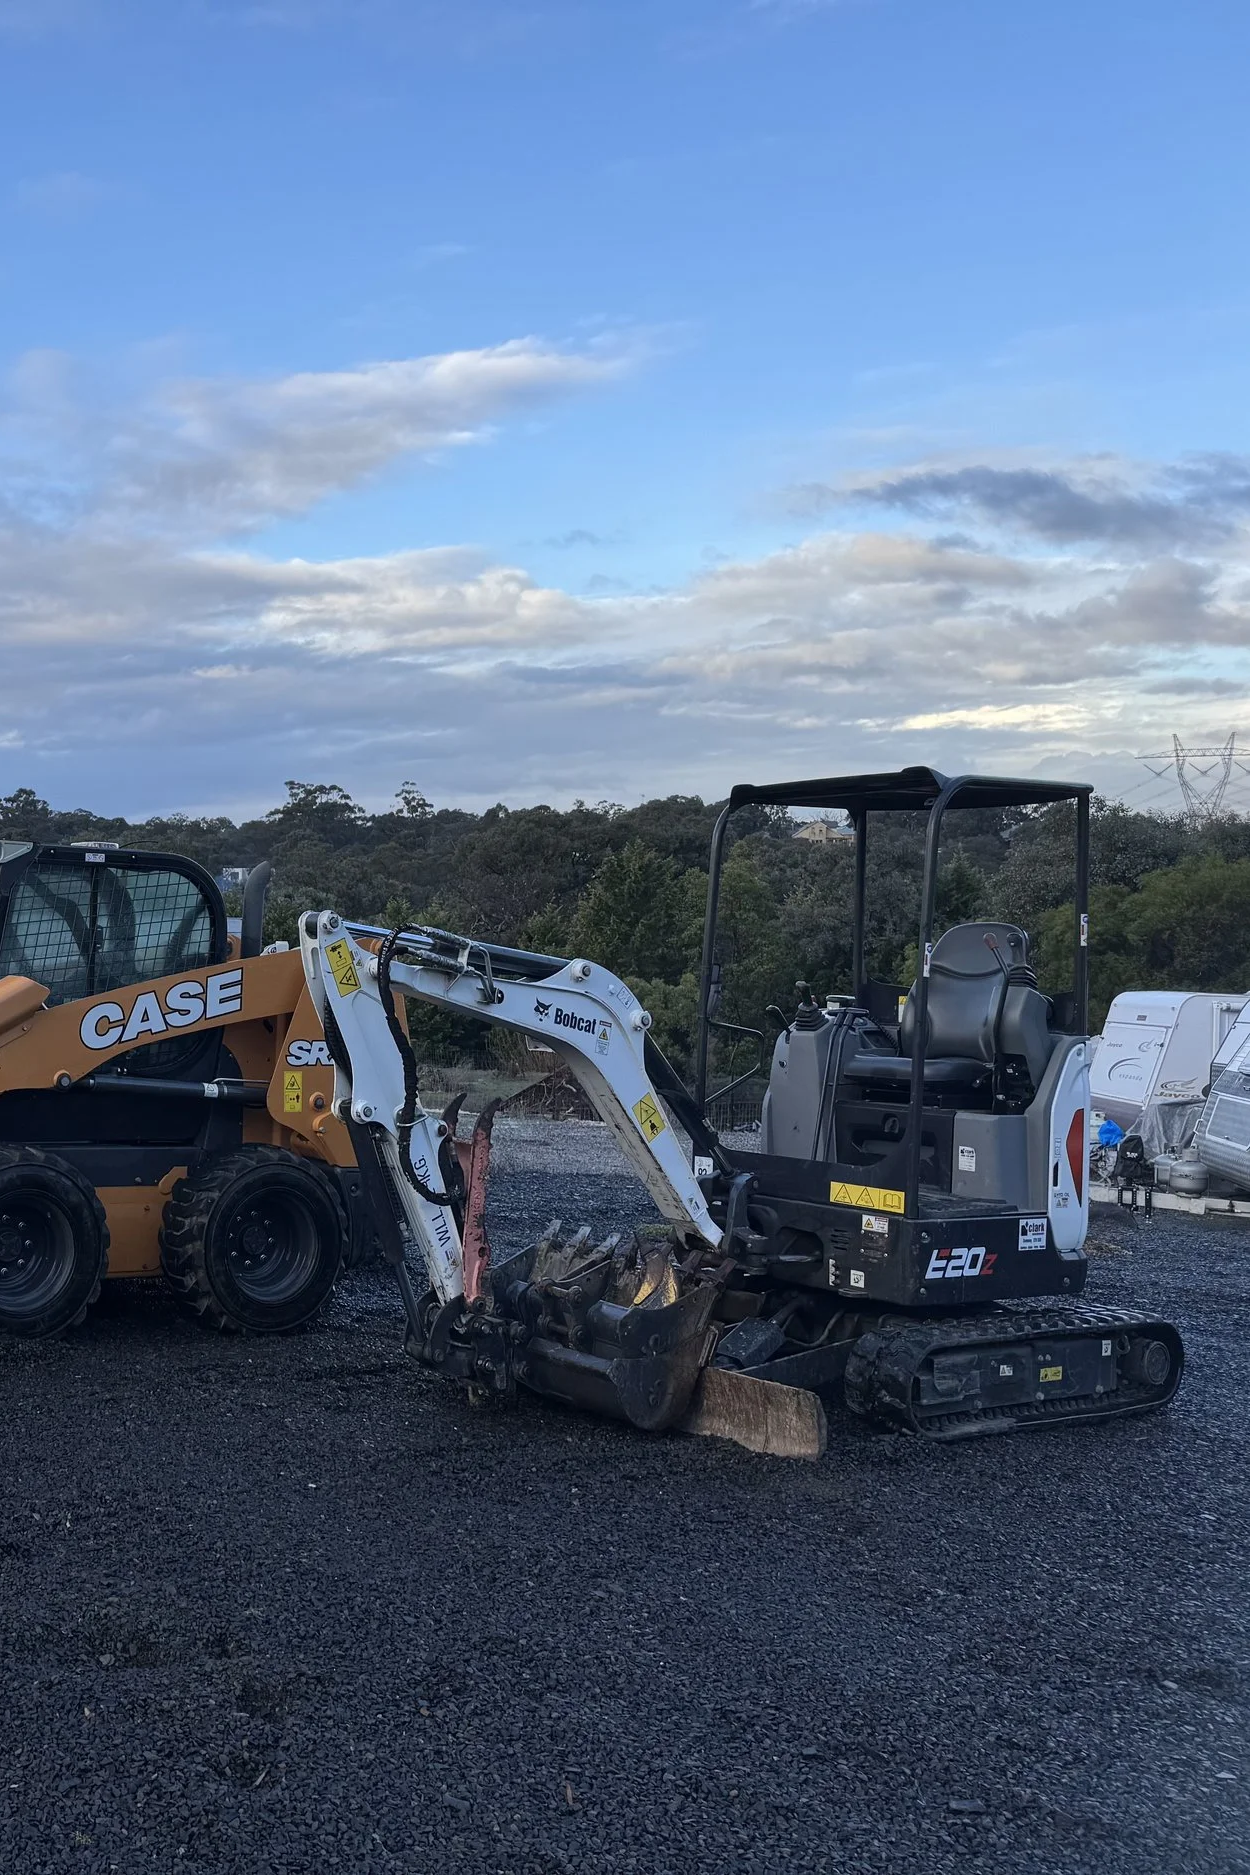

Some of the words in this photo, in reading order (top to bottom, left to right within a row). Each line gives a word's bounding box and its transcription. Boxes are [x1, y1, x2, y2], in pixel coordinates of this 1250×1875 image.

[79, 966, 244, 1050] CASE
[553, 1007, 597, 1035] Bobcat
[286, 1039, 335, 1067] SR
[1154, 1091, 1201, 1099] Jayco
[1028, 1222, 1045, 1233] clark
